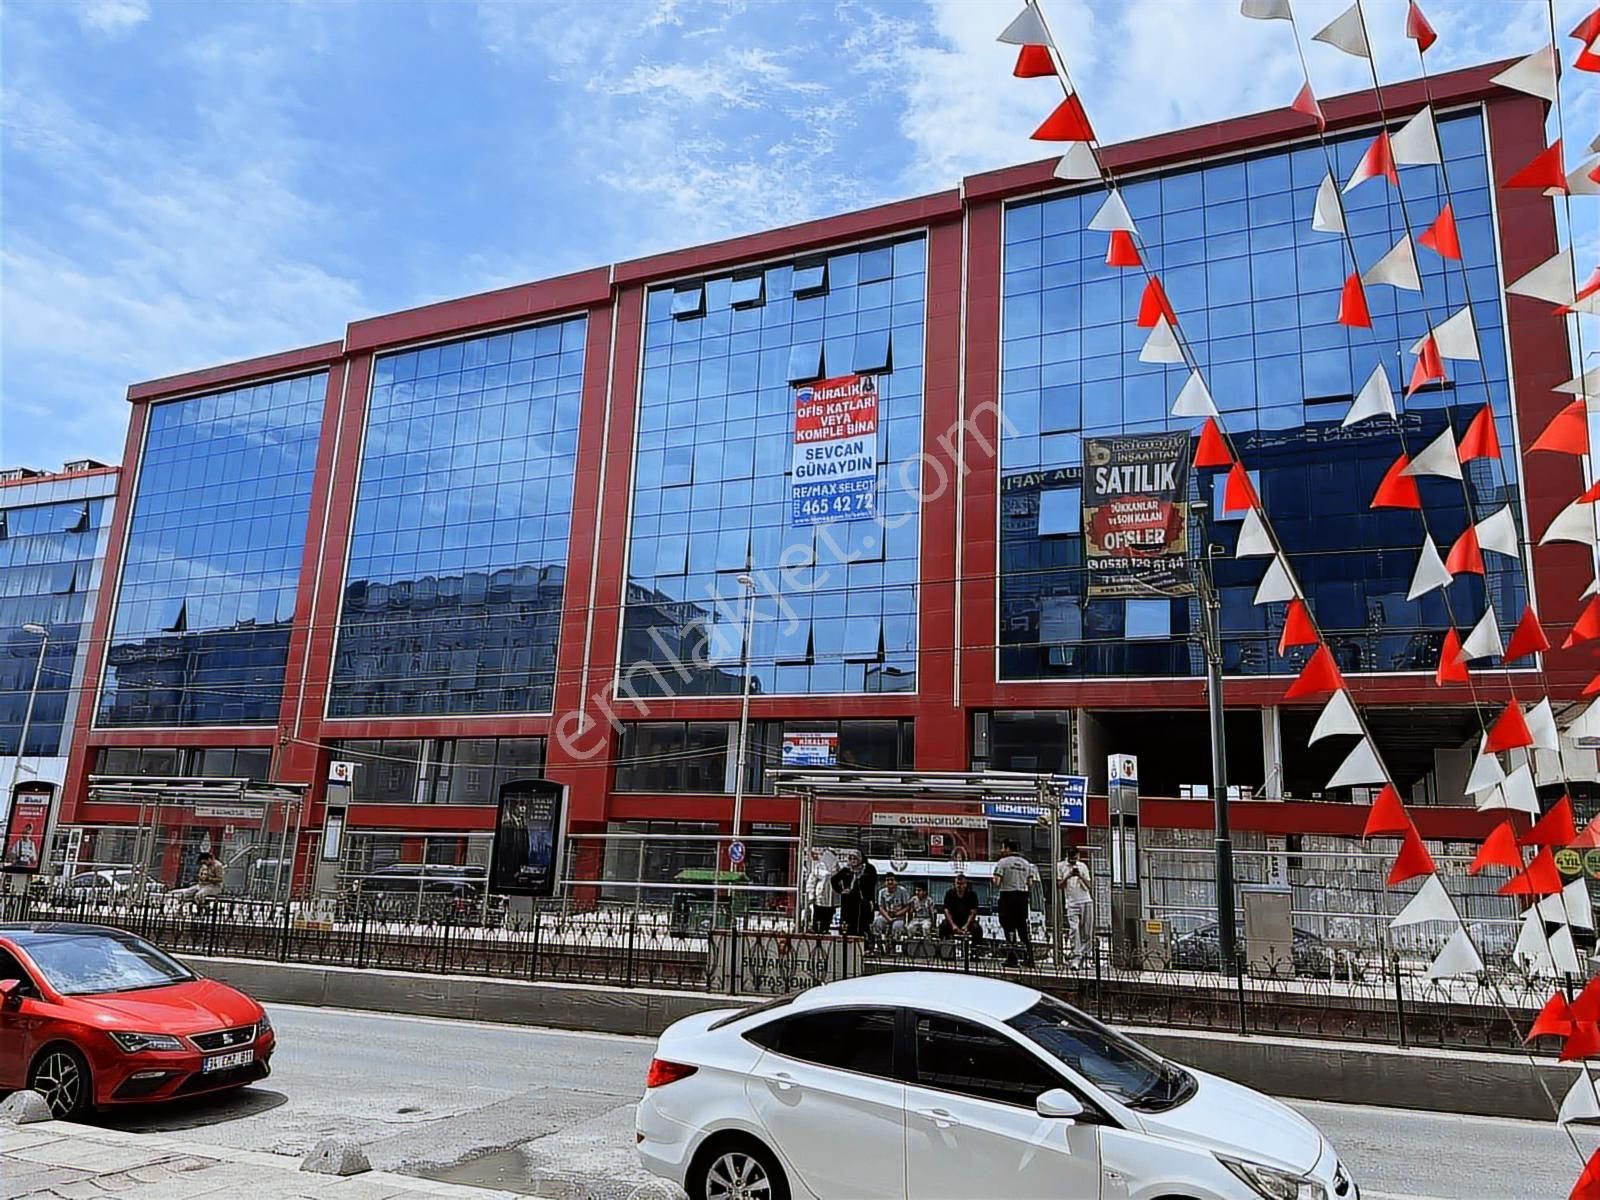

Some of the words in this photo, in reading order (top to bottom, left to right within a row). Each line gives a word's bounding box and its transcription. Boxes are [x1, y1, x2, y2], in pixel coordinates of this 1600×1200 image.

[813, 384, 859, 401] KİRALIK
[797, 404, 823, 418] OFİS
[827, 397, 875, 415] KATLARI
[796, 425, 844, 441] KOMPLE
[847, 420, 875, 435] BİNA
[820, 413, 851, 427] VEYA
[805, 441, 864, 461] SEVCAN
[795, 457, 872, 478] GÜNAYDIN
[1095, 462, 1176, 495] SATILIK
[793, 483, 837, 499] RE/MAX
[838, 480, 875, 493] SELECT
[801, 498, 829, 516] 465
[832, 495, 851, 512] 42
[855, 492, 874, 510] 72
